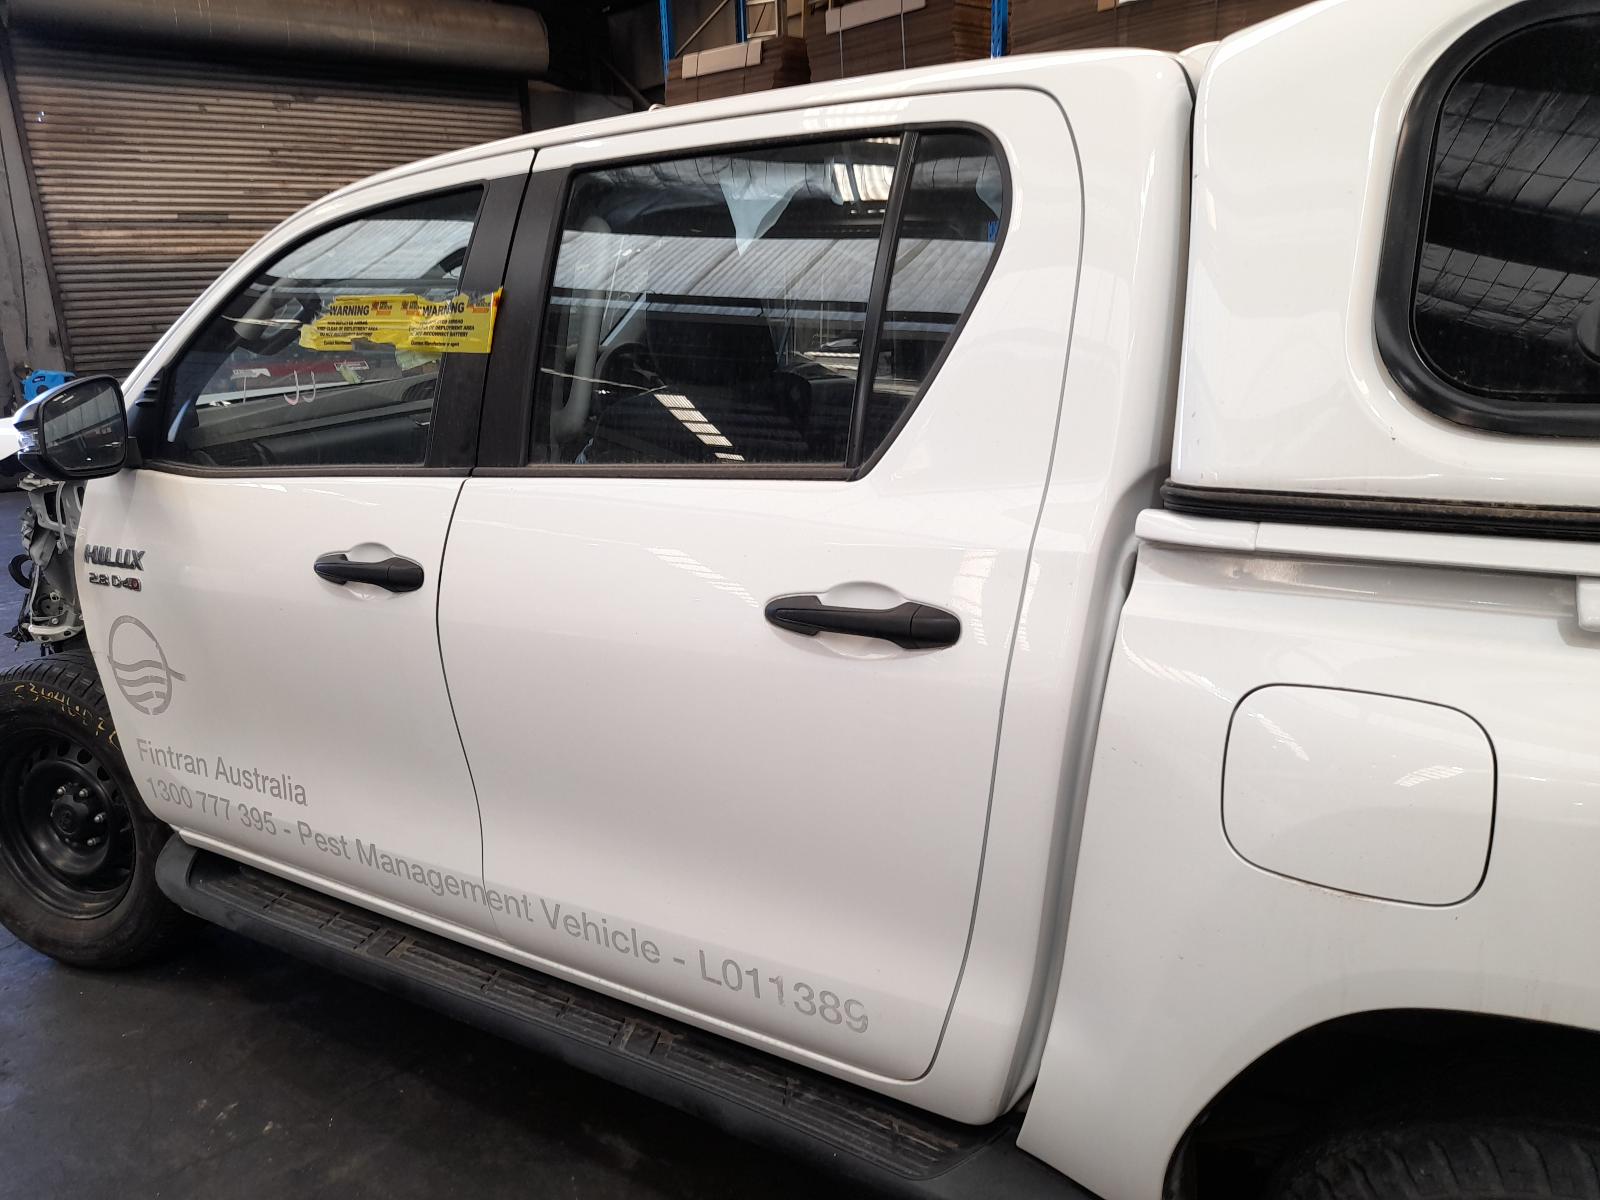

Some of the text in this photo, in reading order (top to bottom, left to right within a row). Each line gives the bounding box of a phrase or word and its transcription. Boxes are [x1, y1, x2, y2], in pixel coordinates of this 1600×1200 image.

[329, 305, 370, 316] WARNING
[84, 544, 146, 571] HILUX
[136, 738, 308, 807] Fintran Australia
[146, 777, 193, 809] 1300
[196, 791, 231, 821] 777
[238, 803, 277, 836] 395
[297, 820, 351, 860] Pest
[355, 839, 534, 922] Management
[540, 898, 661, 965] Vehicle
[699, 949, 869, 1034] L011389
